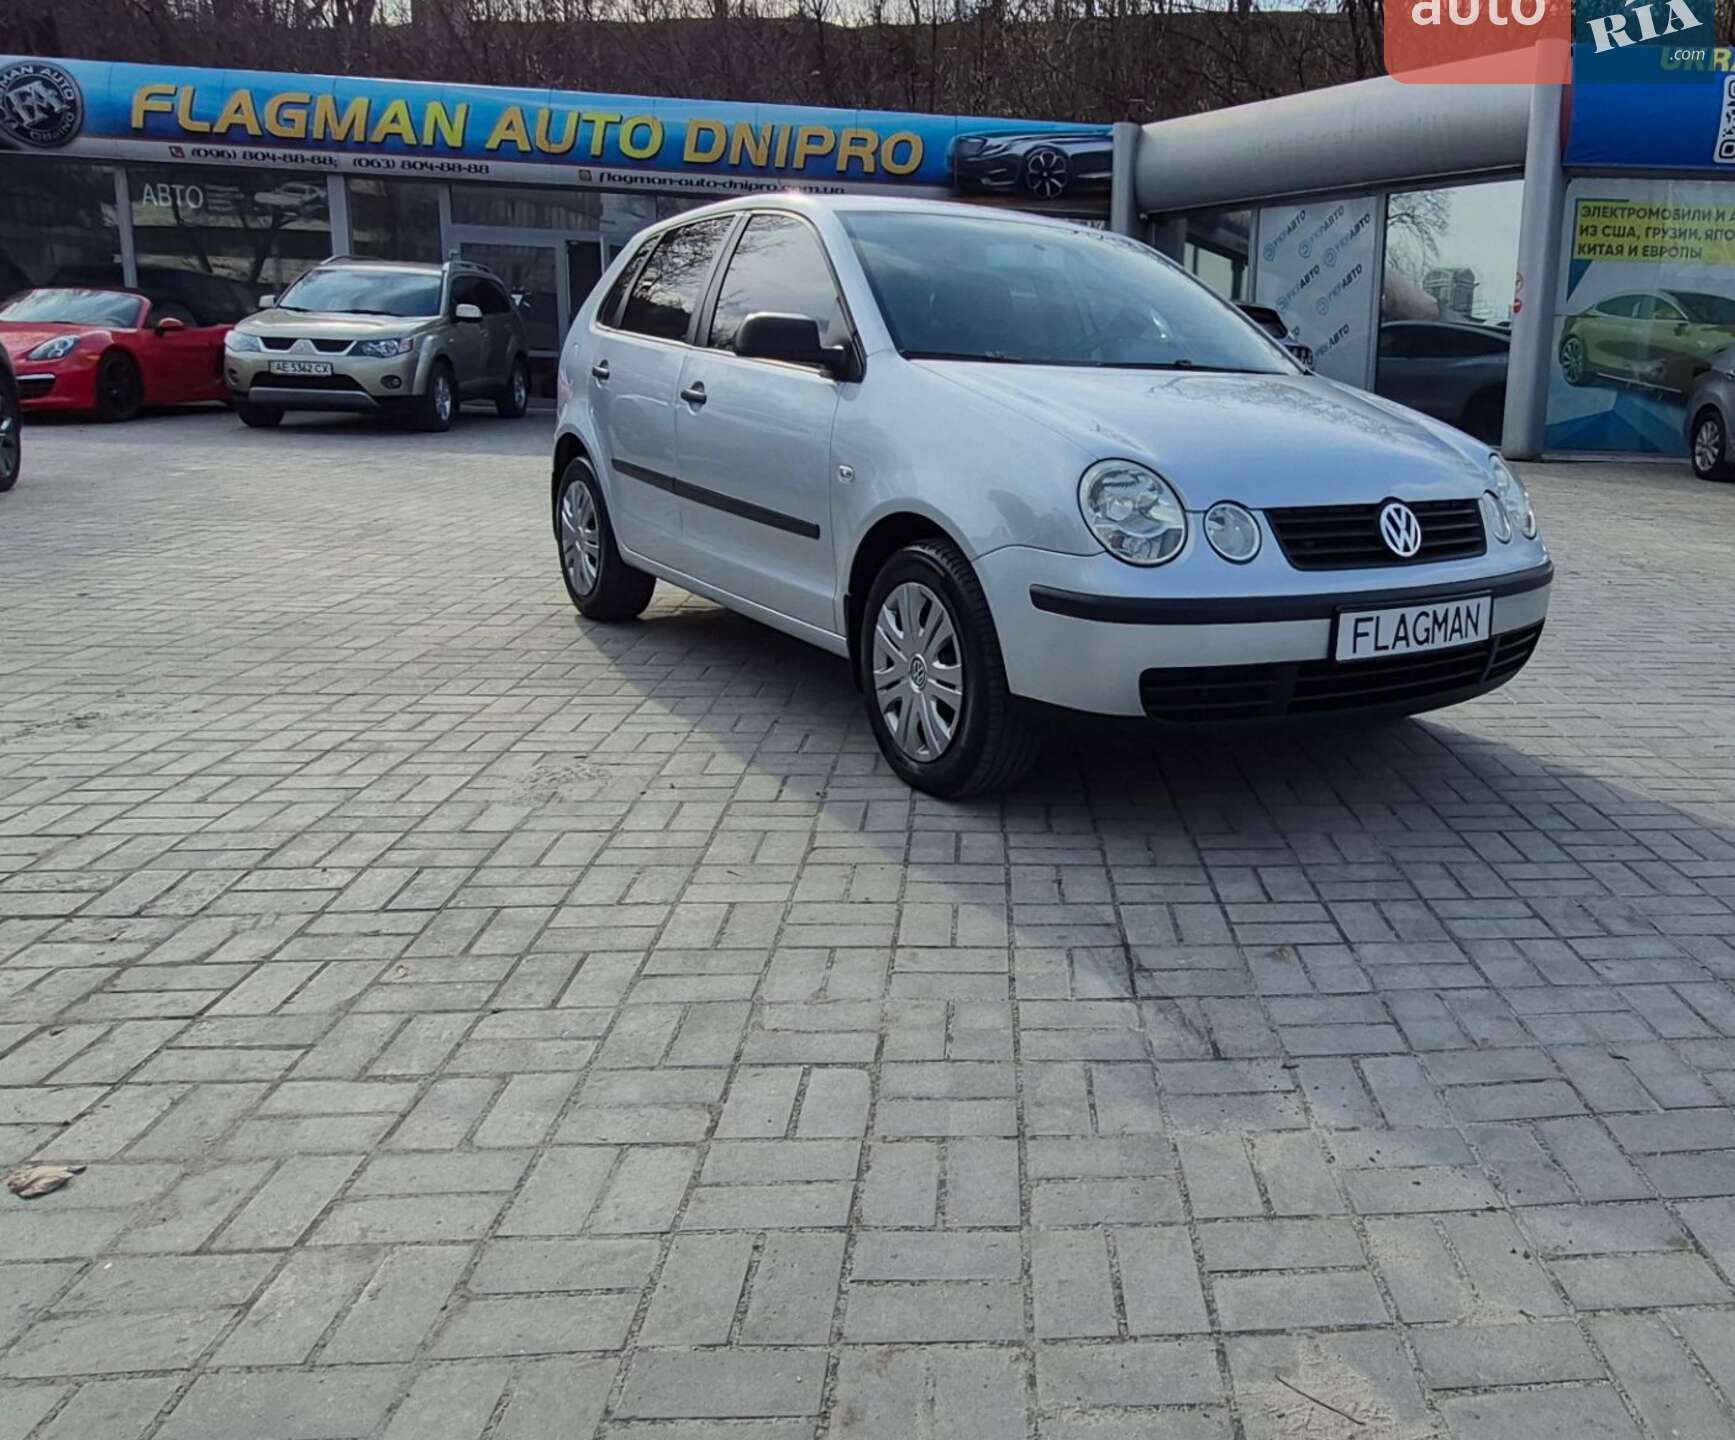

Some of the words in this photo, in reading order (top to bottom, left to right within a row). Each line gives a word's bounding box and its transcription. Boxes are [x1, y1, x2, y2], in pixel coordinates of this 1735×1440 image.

[1660, 47, 1735, 71] UKR
[41, 68, 75, 100] AUTO
[131, 85, 468, 148] FLAGMAN
[485, 105, 663, 159] AUTO
[683, 119, 924, 175] DNIPRO
[191, 147, 237, 160] (096)
[353, 157, 396, 169] (063)
[401, 160, 490, 174] 804-88-88
[142, 184, 204, 208] АВТО
[1581, 206, 1711, 221] ЭЛЕКТРОМОБИЛИ
[1715, 210, 1725, 221] И
[1579, 225, 1598, 237] ИЗ
[1602, 226, 1640, 240] США,
[1645, 226, 1701, 241] ГРУЗИИ,
[1577, 243, 1624, 255] КИТАЯ
[1628, 244, 1638, 255] И
[1642, 245, 1703, 258] ЕВРОПЫ
[1352, 603, 1481, 654] FLAGMAN
